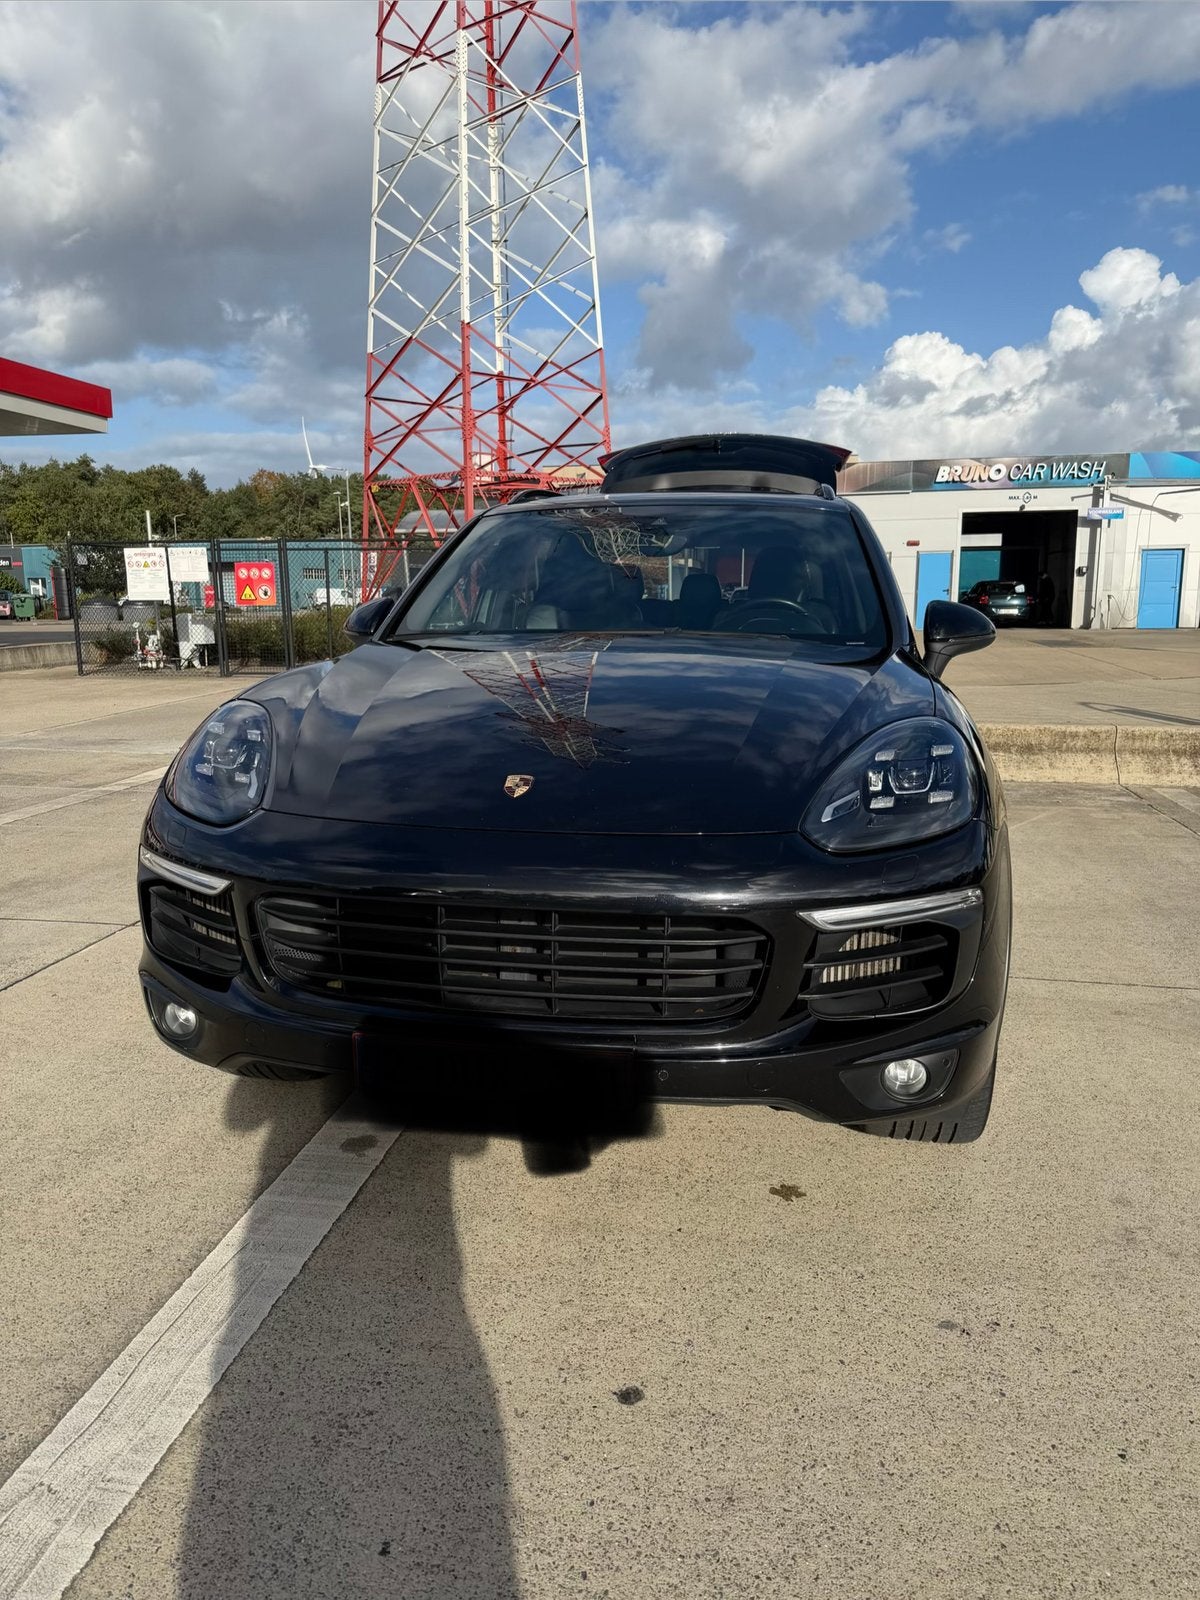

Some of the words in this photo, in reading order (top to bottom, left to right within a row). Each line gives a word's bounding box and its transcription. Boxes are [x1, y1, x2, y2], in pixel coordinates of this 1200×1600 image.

[935, 463, 1006, 483] BRUNO
[1009, 463, 1047, 480] CAR
[1052, 461, 1107, 478] WASH
